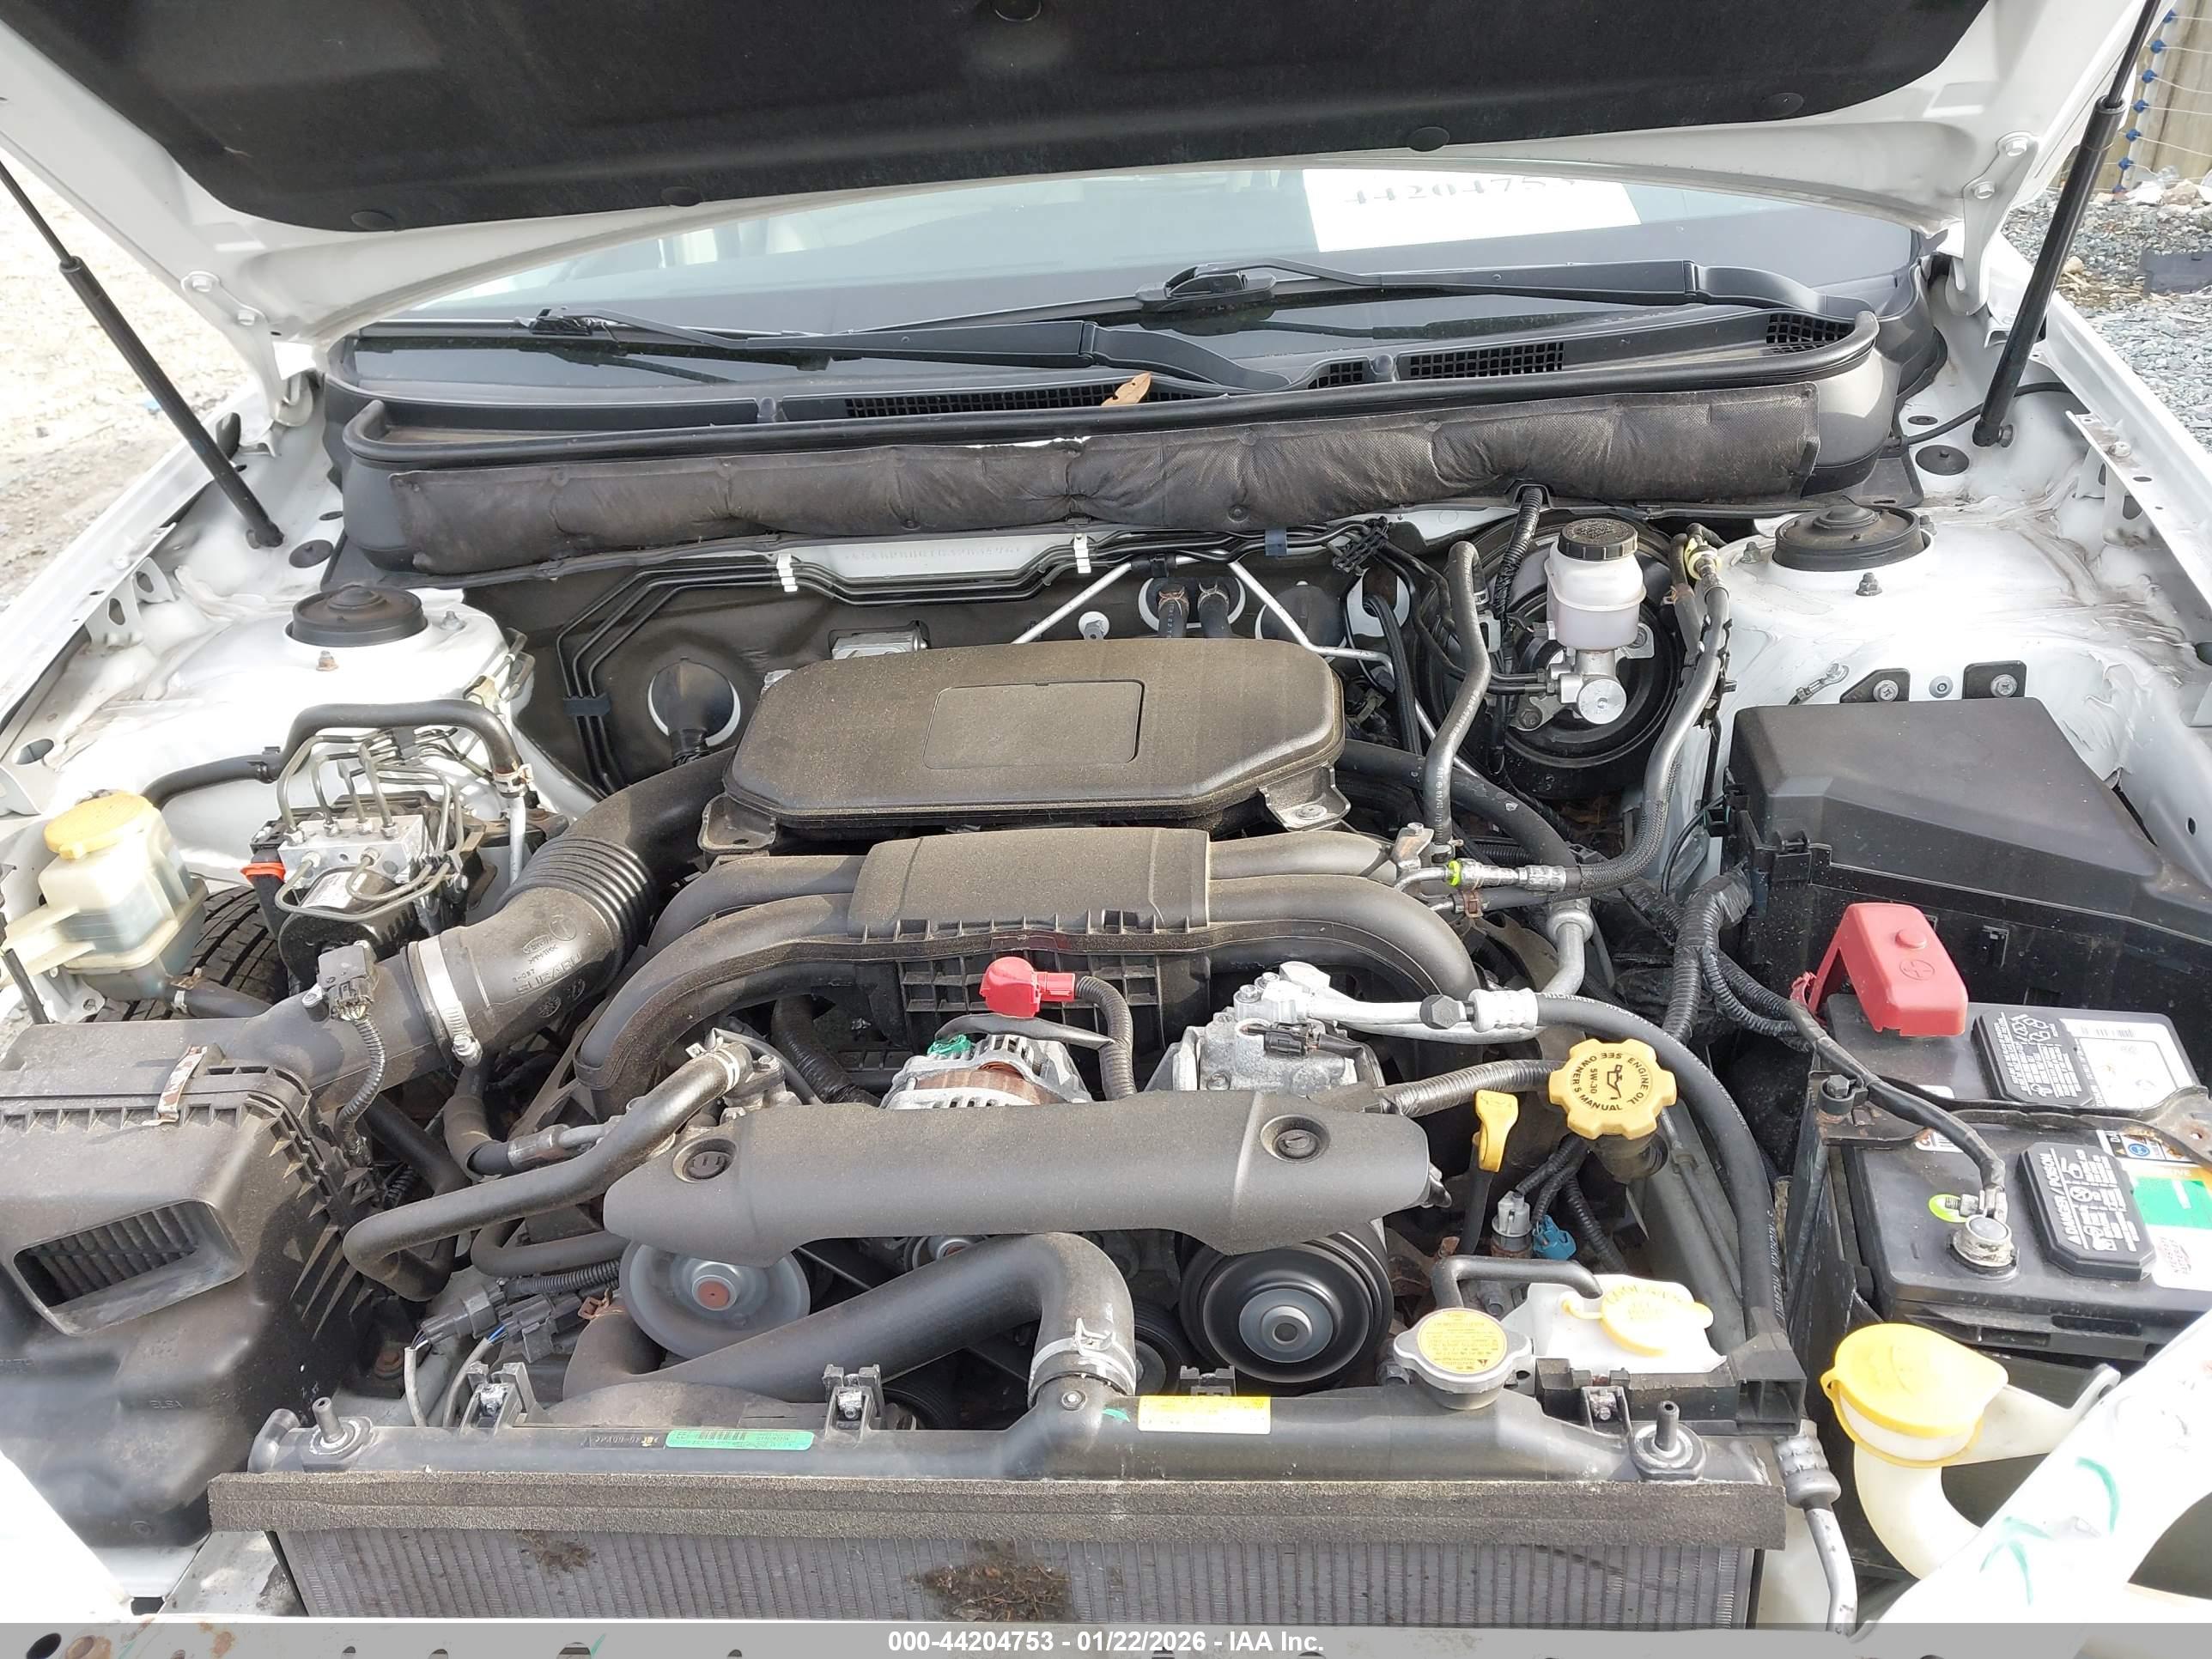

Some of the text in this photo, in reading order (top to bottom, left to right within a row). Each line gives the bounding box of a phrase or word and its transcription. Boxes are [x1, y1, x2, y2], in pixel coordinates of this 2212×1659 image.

[1344, 176, 1575, 204] 4420475
[1589, 1068, 1598, 1094] 5W-30
[1627, 1057, 1649, 1105] ENGINE OIL
[1579, 1094, 1623, 1111] MANUAL
[2039, 1152, 2063, 1187] POISON
[2053, 1194, 2079, 1237] DANGER
